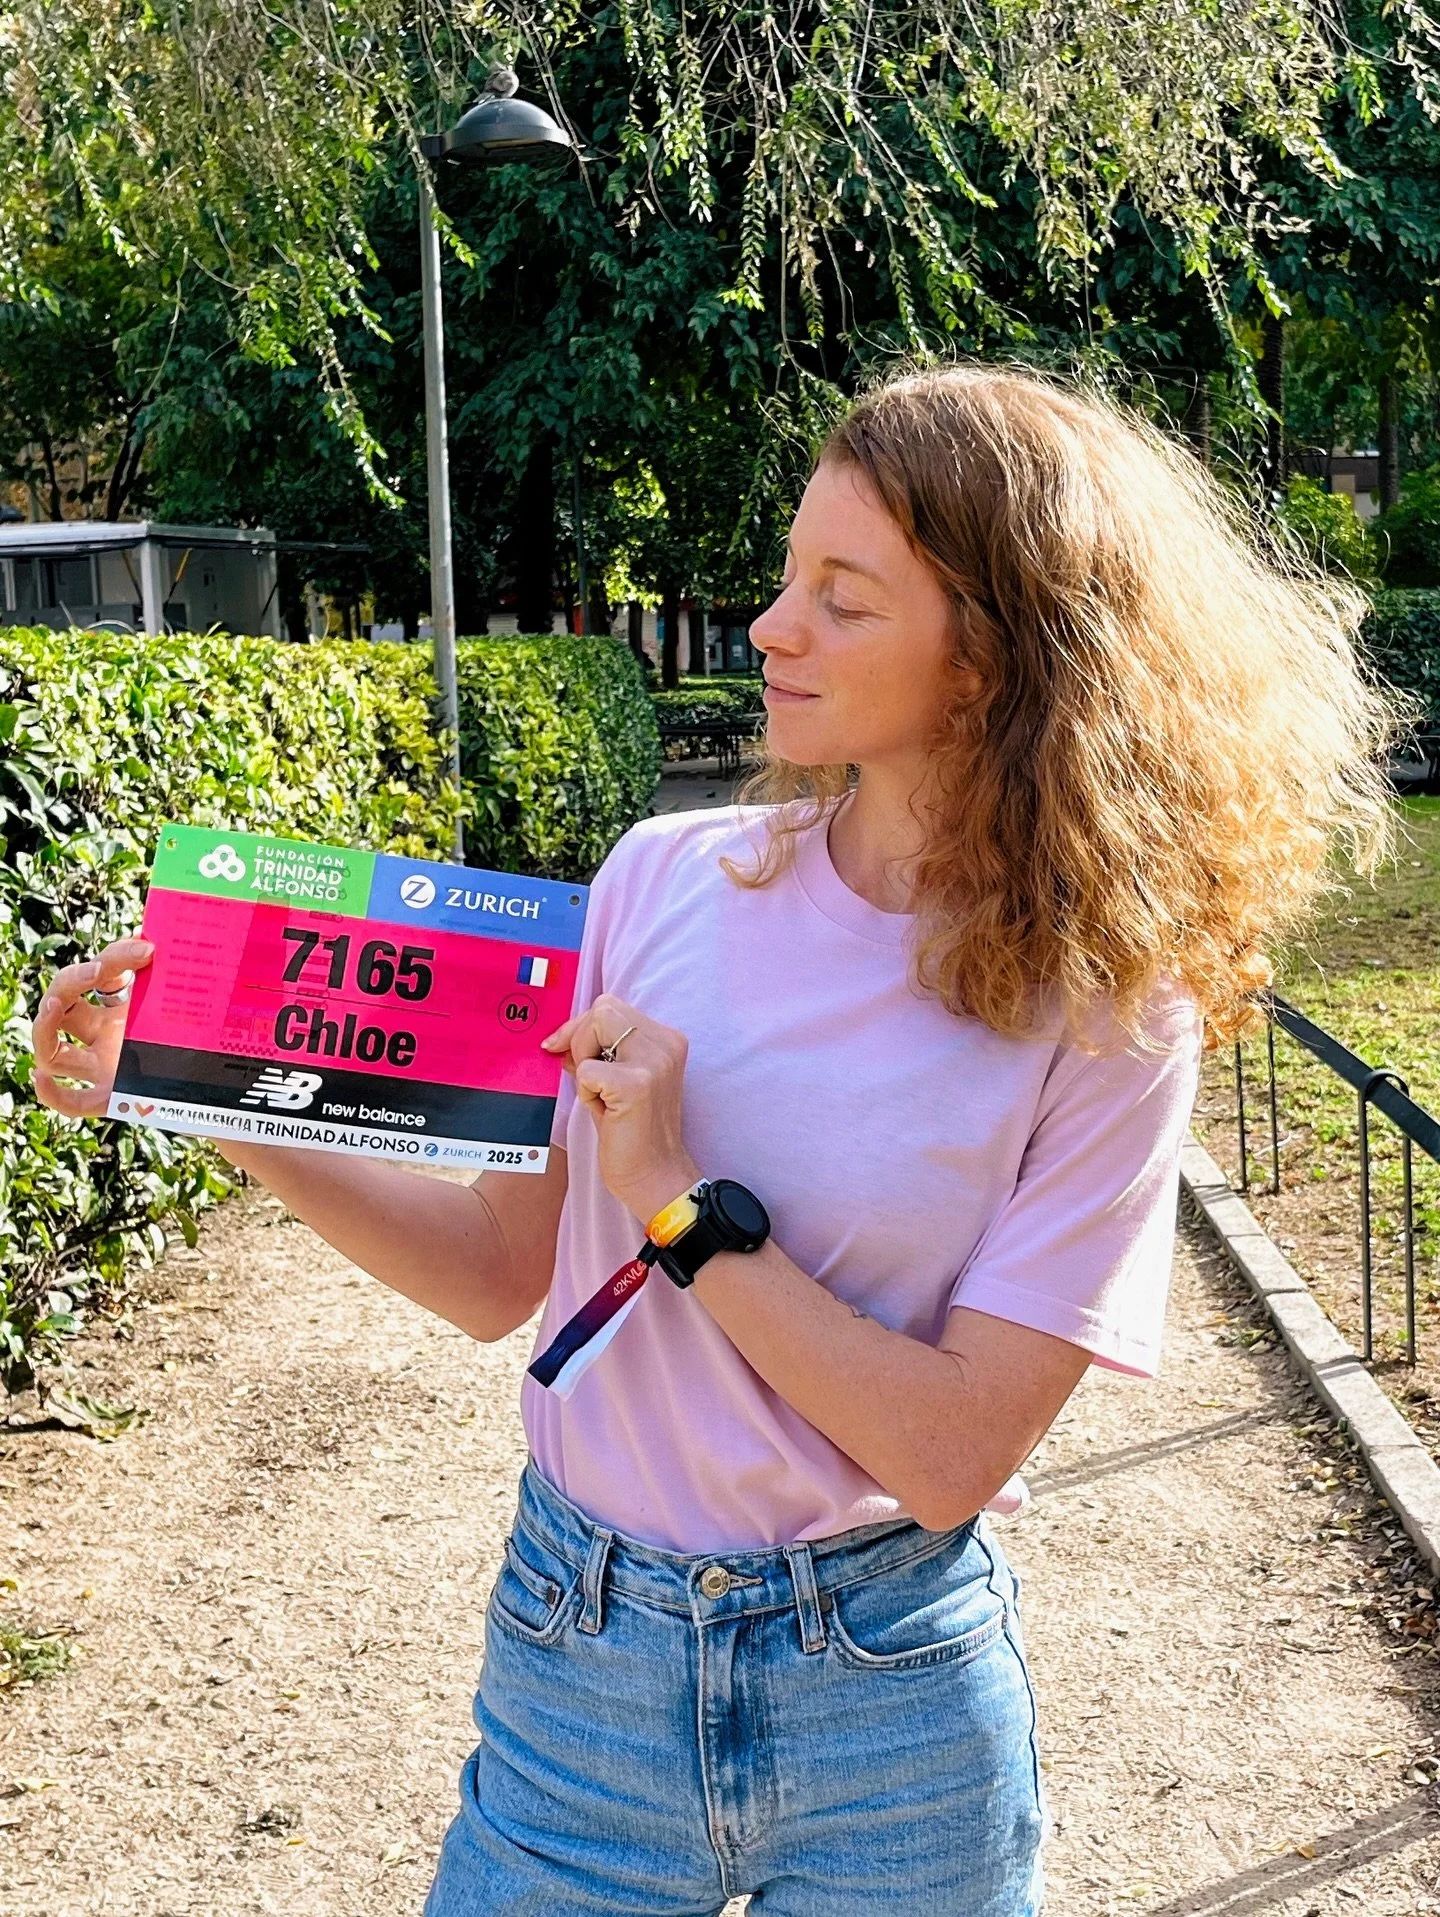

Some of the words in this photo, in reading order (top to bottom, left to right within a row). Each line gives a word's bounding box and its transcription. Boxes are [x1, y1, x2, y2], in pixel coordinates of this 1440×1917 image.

[256, 845, 345, 868] FUNDACIÓN
[253, 858, 343, 885] TRINIDAD
[250, 875, 339, 901] ALFONSO
[445, 888, 541, 919] ZURICH
[282, 927, 436, 1002] 7165
[505, 1003, 529, 1022] 04
[274, 1005, 417, 1067] Chloe
[322, 1102, 356, 1118] new
[358, 1104, 426, 1127] balance
[256, 1120, 336, 1143] TRINIDAD
[337, 1132, 420, 1155] ALFONSO
[442, 1147, 482, 1159] ZURICH
[486, 1149, 523, 1165] 2025
